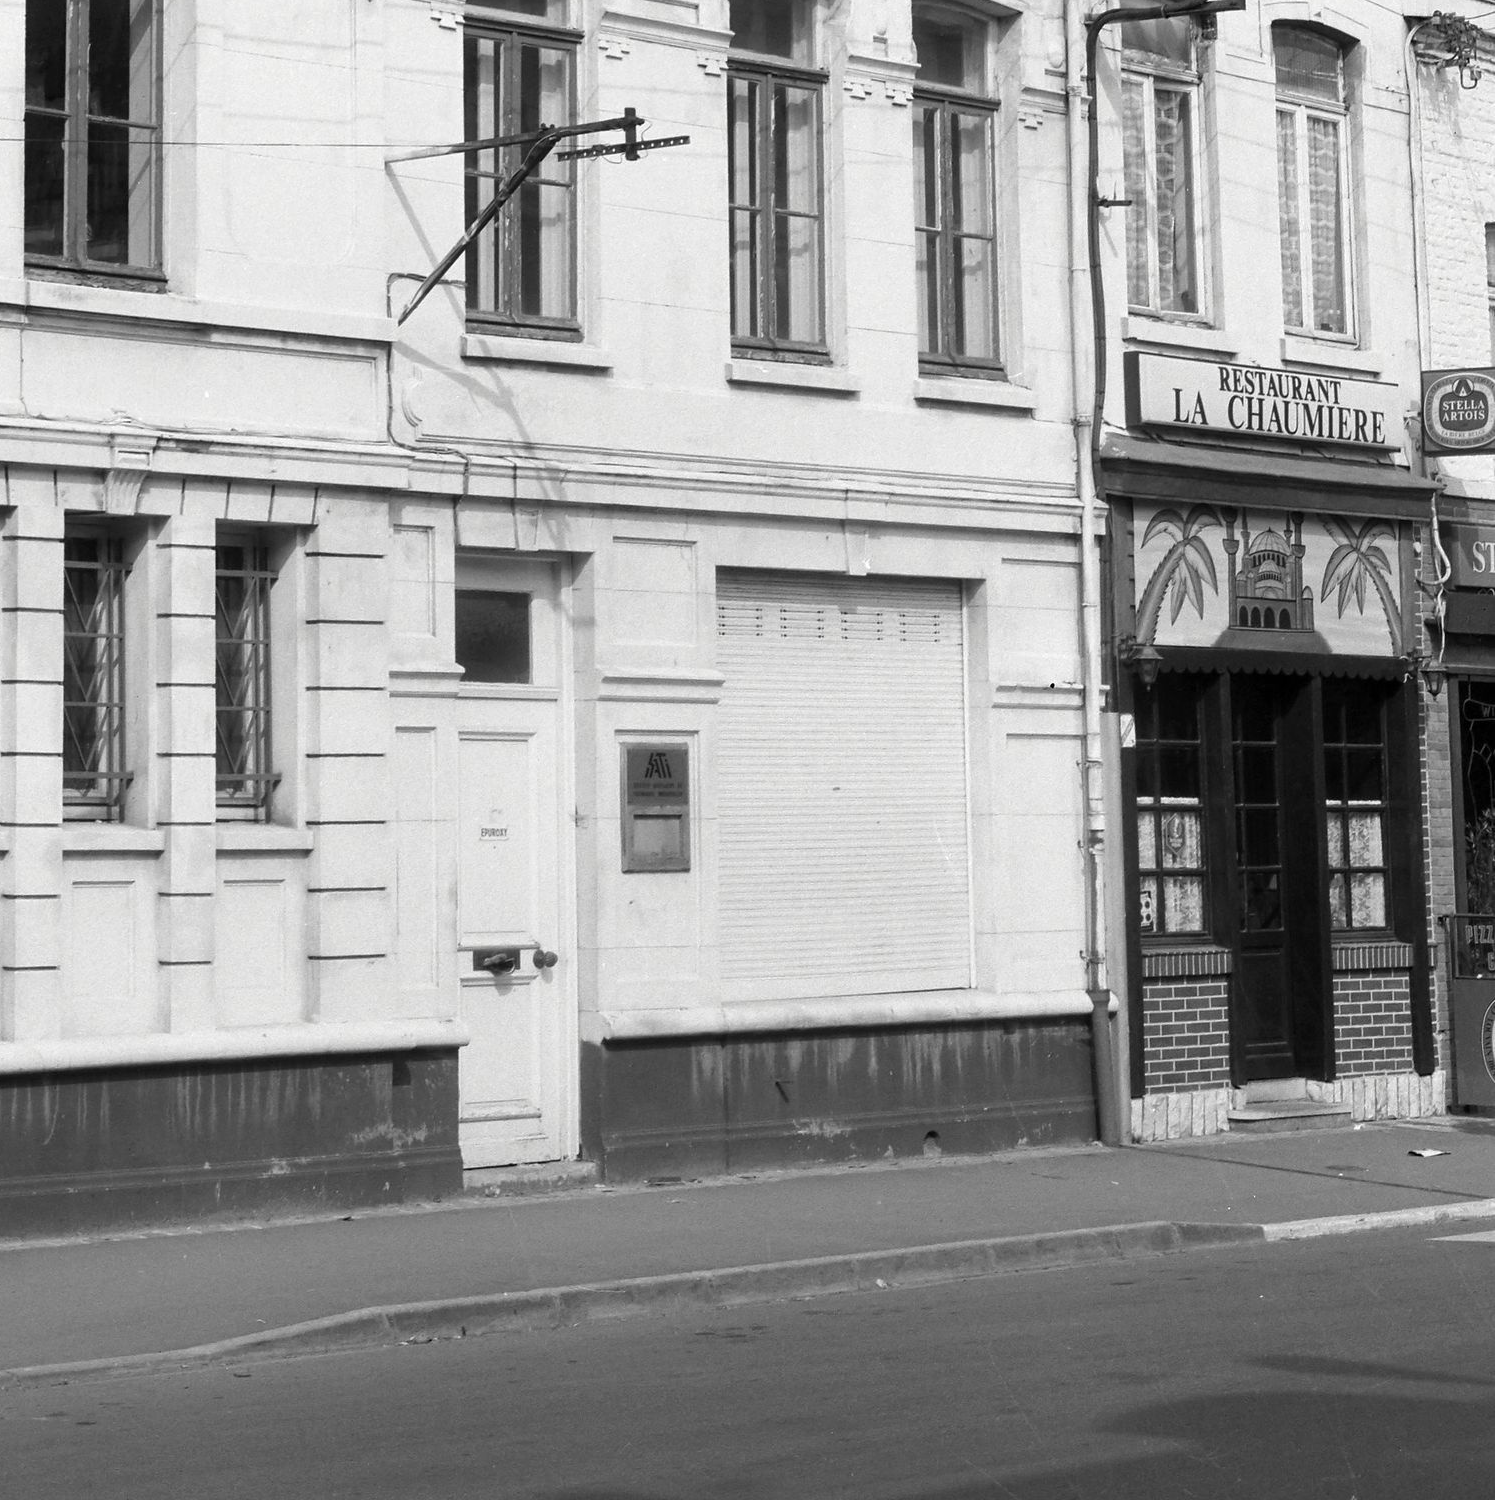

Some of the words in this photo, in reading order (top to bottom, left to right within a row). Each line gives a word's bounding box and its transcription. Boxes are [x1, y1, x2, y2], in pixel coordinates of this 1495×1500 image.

[1218, 366, 1342, 404] RESTAURANT
[1172, 388, 1208, 425] LA
[1228, 394, 1387, 445] CHAUMIERE
[1442, 399, 1485, 411] STELLA
[1442, 410, 1485, 422] ARTOIS
